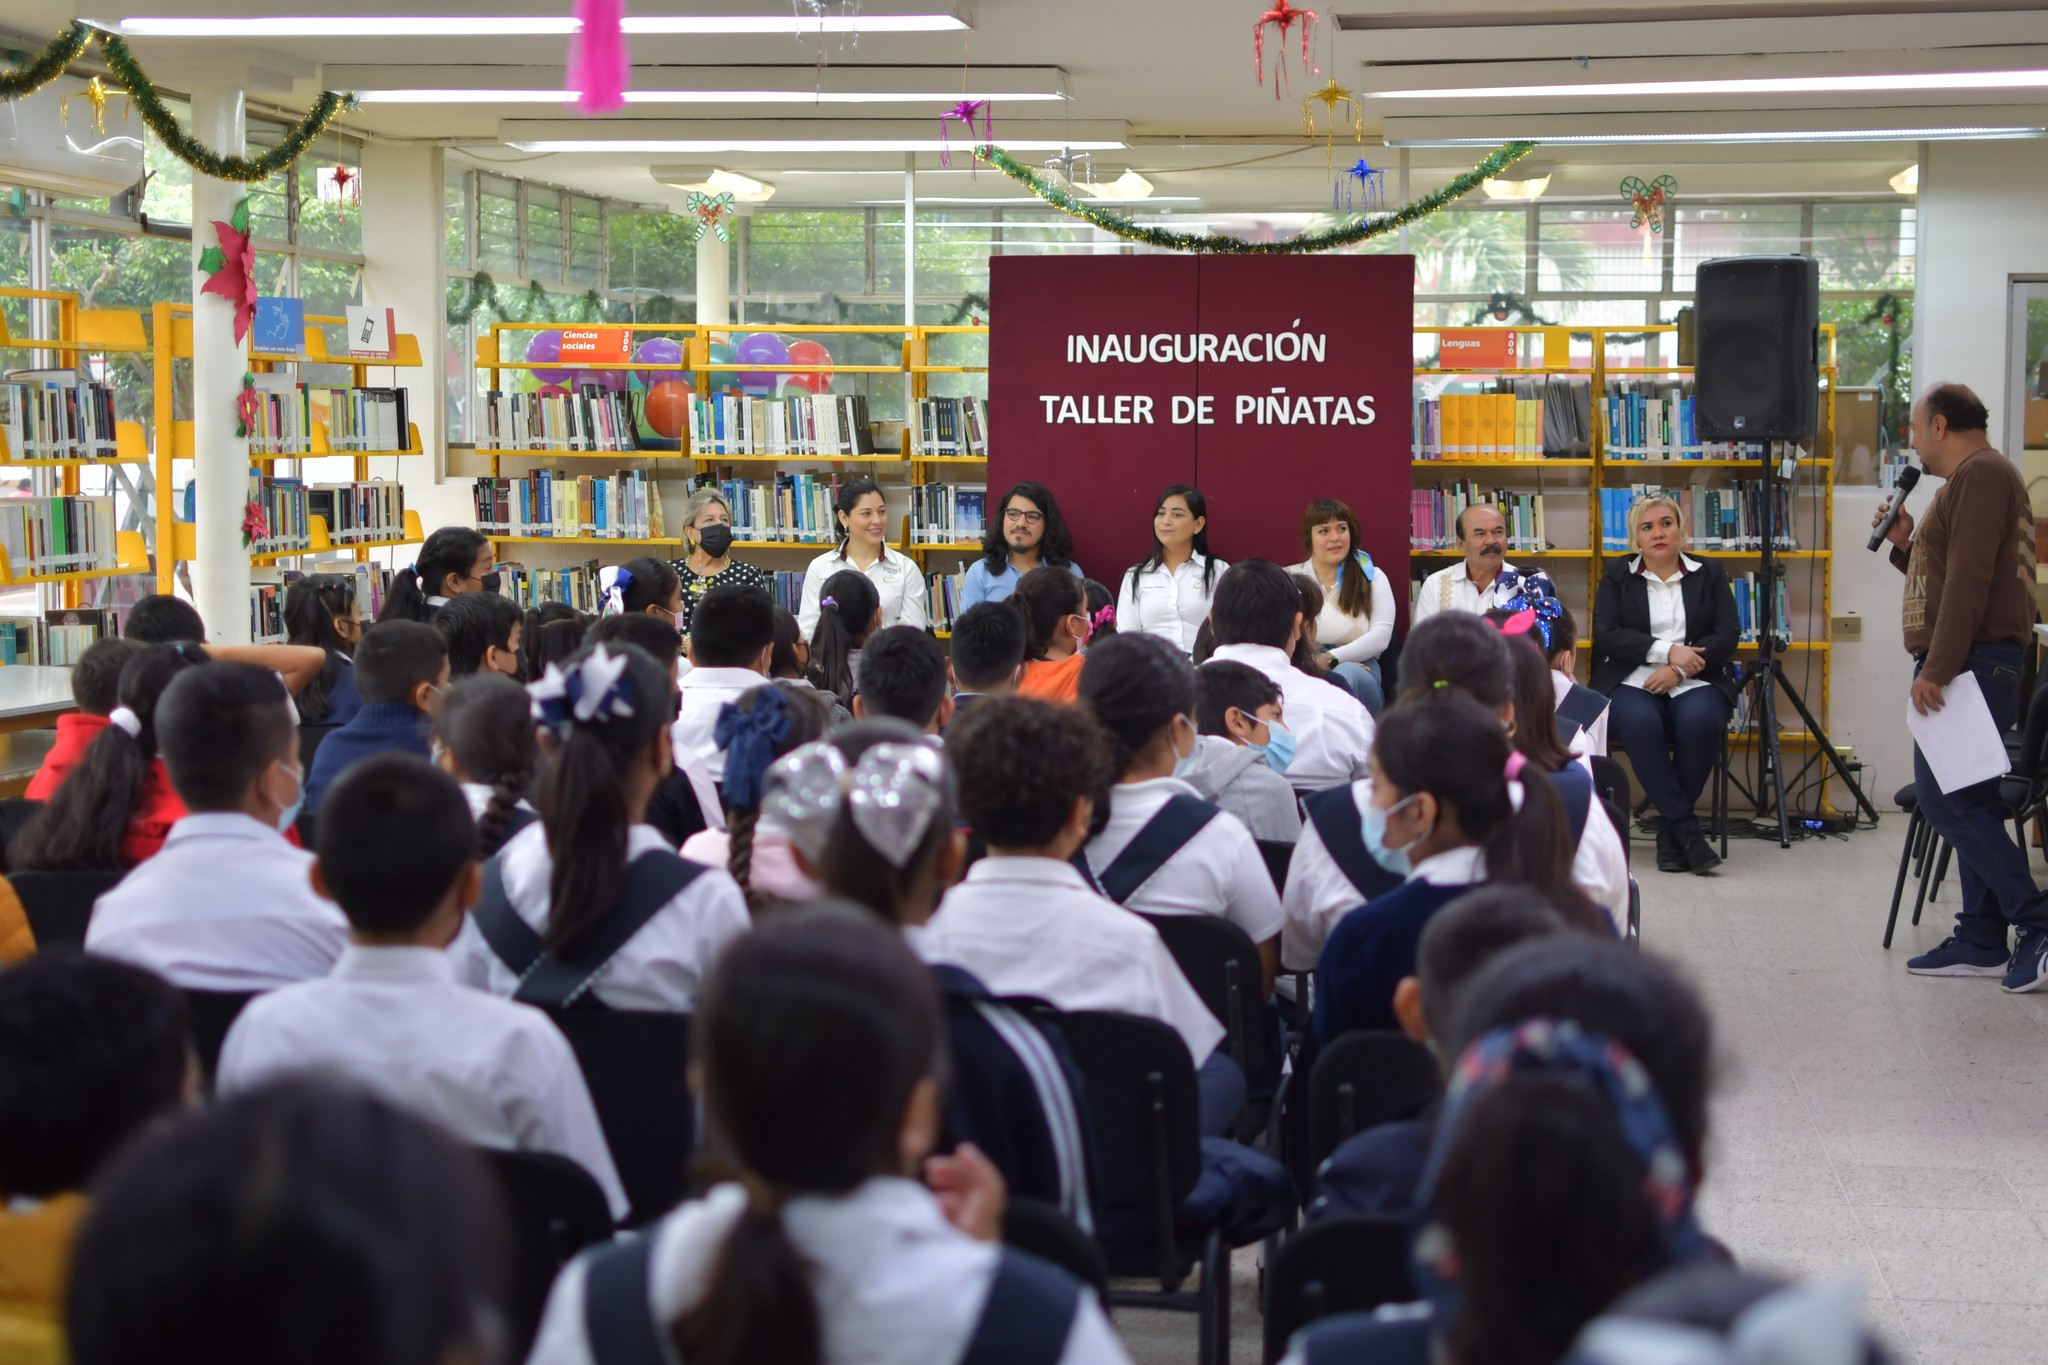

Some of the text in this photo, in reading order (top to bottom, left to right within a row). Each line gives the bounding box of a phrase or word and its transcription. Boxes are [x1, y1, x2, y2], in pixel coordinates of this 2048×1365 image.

[563, 331, 598, 339] Ciencias
[622, 331, 630, 352] 300
[1067, 318, 1326, 363] INAUGURACIÓN
[562, 342, 596, 350] sociales
[1442, 339, 1480, 349] Lenguas
[1039, 387, 1376, 425] TALLER DE PIÑATAS
